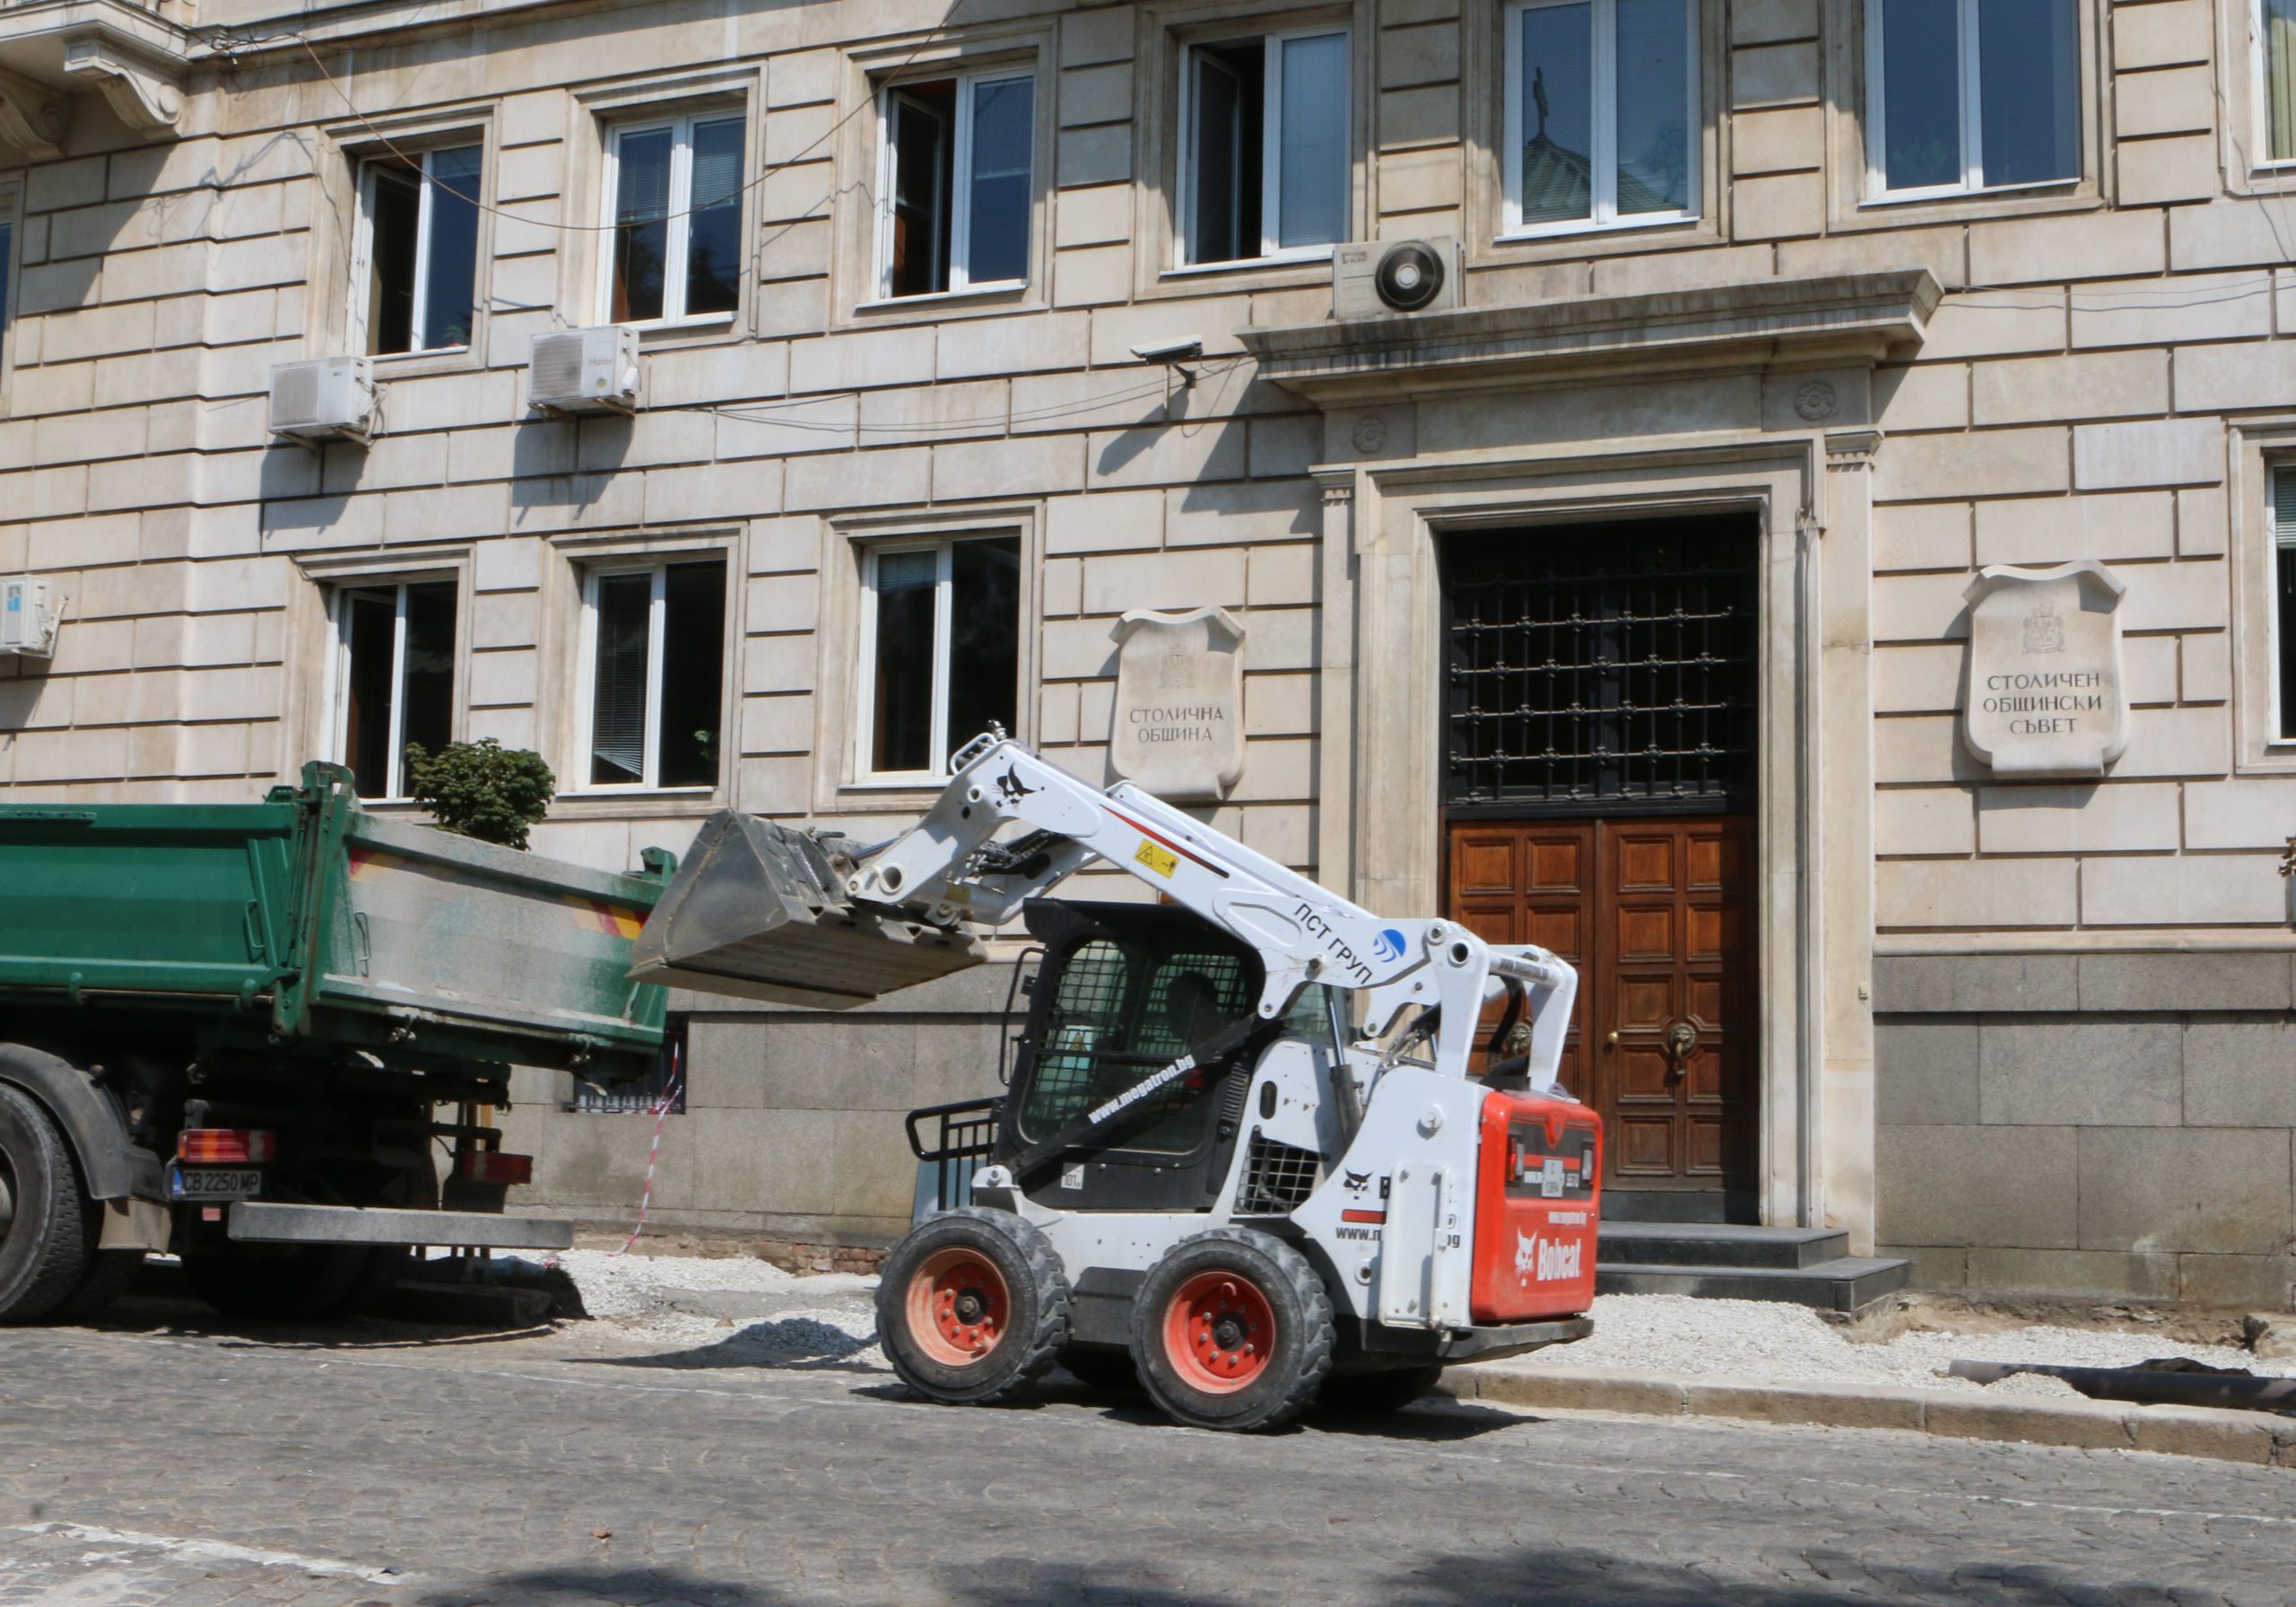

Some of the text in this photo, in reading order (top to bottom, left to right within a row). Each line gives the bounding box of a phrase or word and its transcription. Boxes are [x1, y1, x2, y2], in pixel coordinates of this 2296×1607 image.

[1987, 673, 2100, 691] СТОЛИЧЕН
[1982, 694, 2102, 713] ОБЩИНСКИ
[1129, 707, 1223, 724] СТОЛИЧНА
[1137, 727, 1213, 743] ОБЩИНА
[2009, 718, 2077, 734] СЪВЕТ
[1294, 903, 1373, 985] ПСТ ГРУП
[1088, 1054, 1196, 1125] www.megatron.bg
[204, 1172, 239, 1192] 2250
[1536, 1238, 1582, 1281] Bobcat
